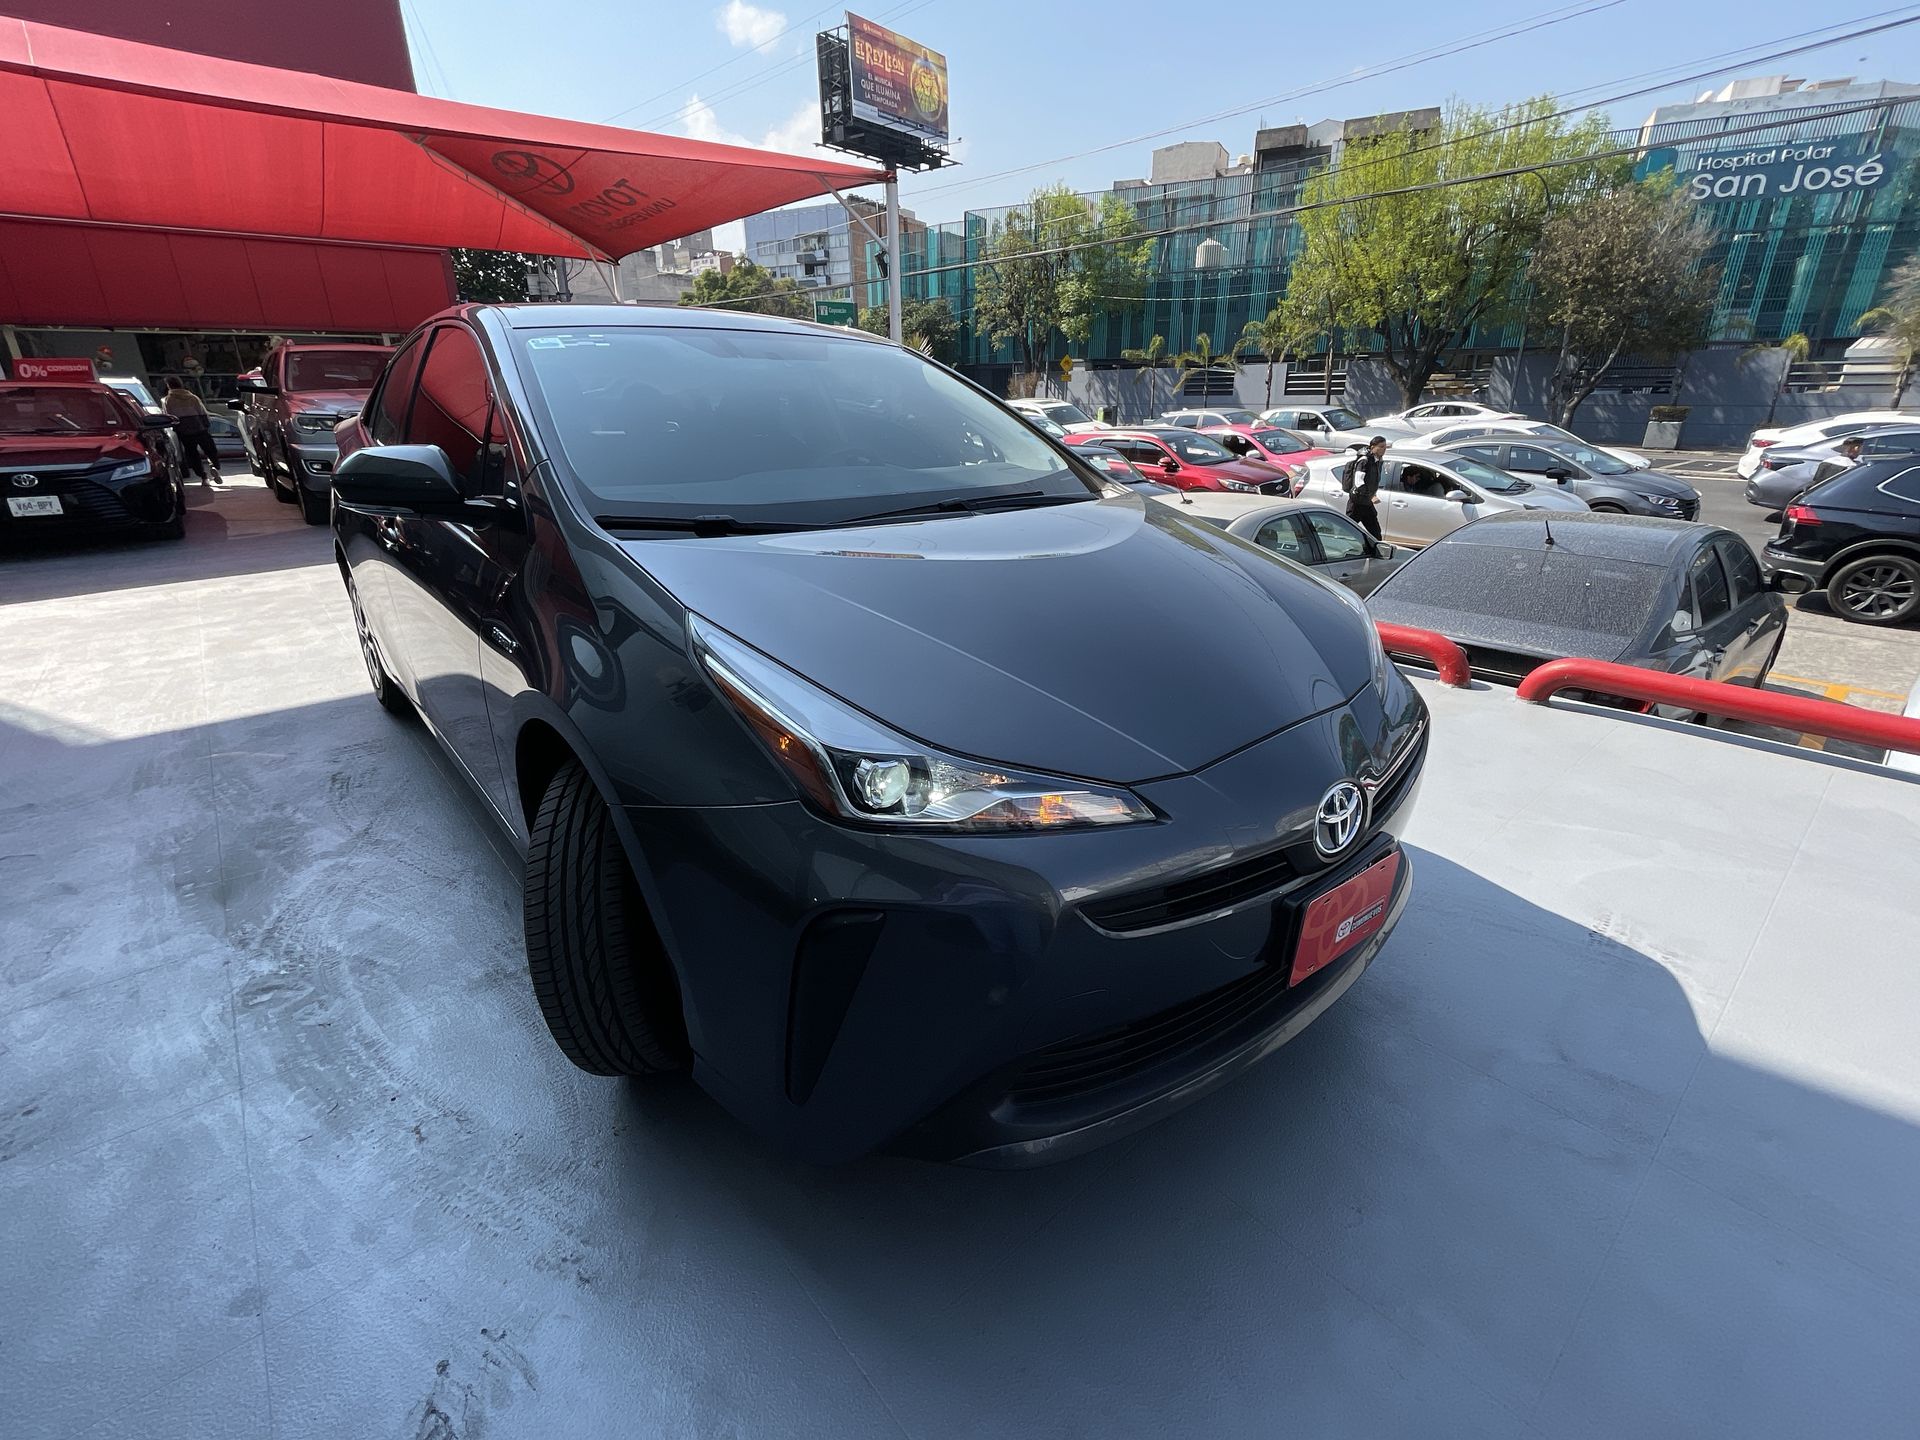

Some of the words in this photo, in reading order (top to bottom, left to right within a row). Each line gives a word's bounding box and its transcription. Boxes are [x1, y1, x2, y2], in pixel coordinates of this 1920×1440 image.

[855, 41, 865, 57] EL
[865, 41, 883, 67] REY
[884, 50, 905, 74] LEÓN
[861, 79, 874, 91] QUE
[875, 84, 901, 102] ILUMINA
[875, 76, 893, 88] MUSICAL
[872, 94, 898, 108] TEMPORADA
[1697, 149, 1775, 172] Hospital
[1781, 145, 1837, 163] Polar
[1691, 173, 1767, 201] San
[1779, 153, 1884, 193] José
[19, 363, 47, 378] 0%
